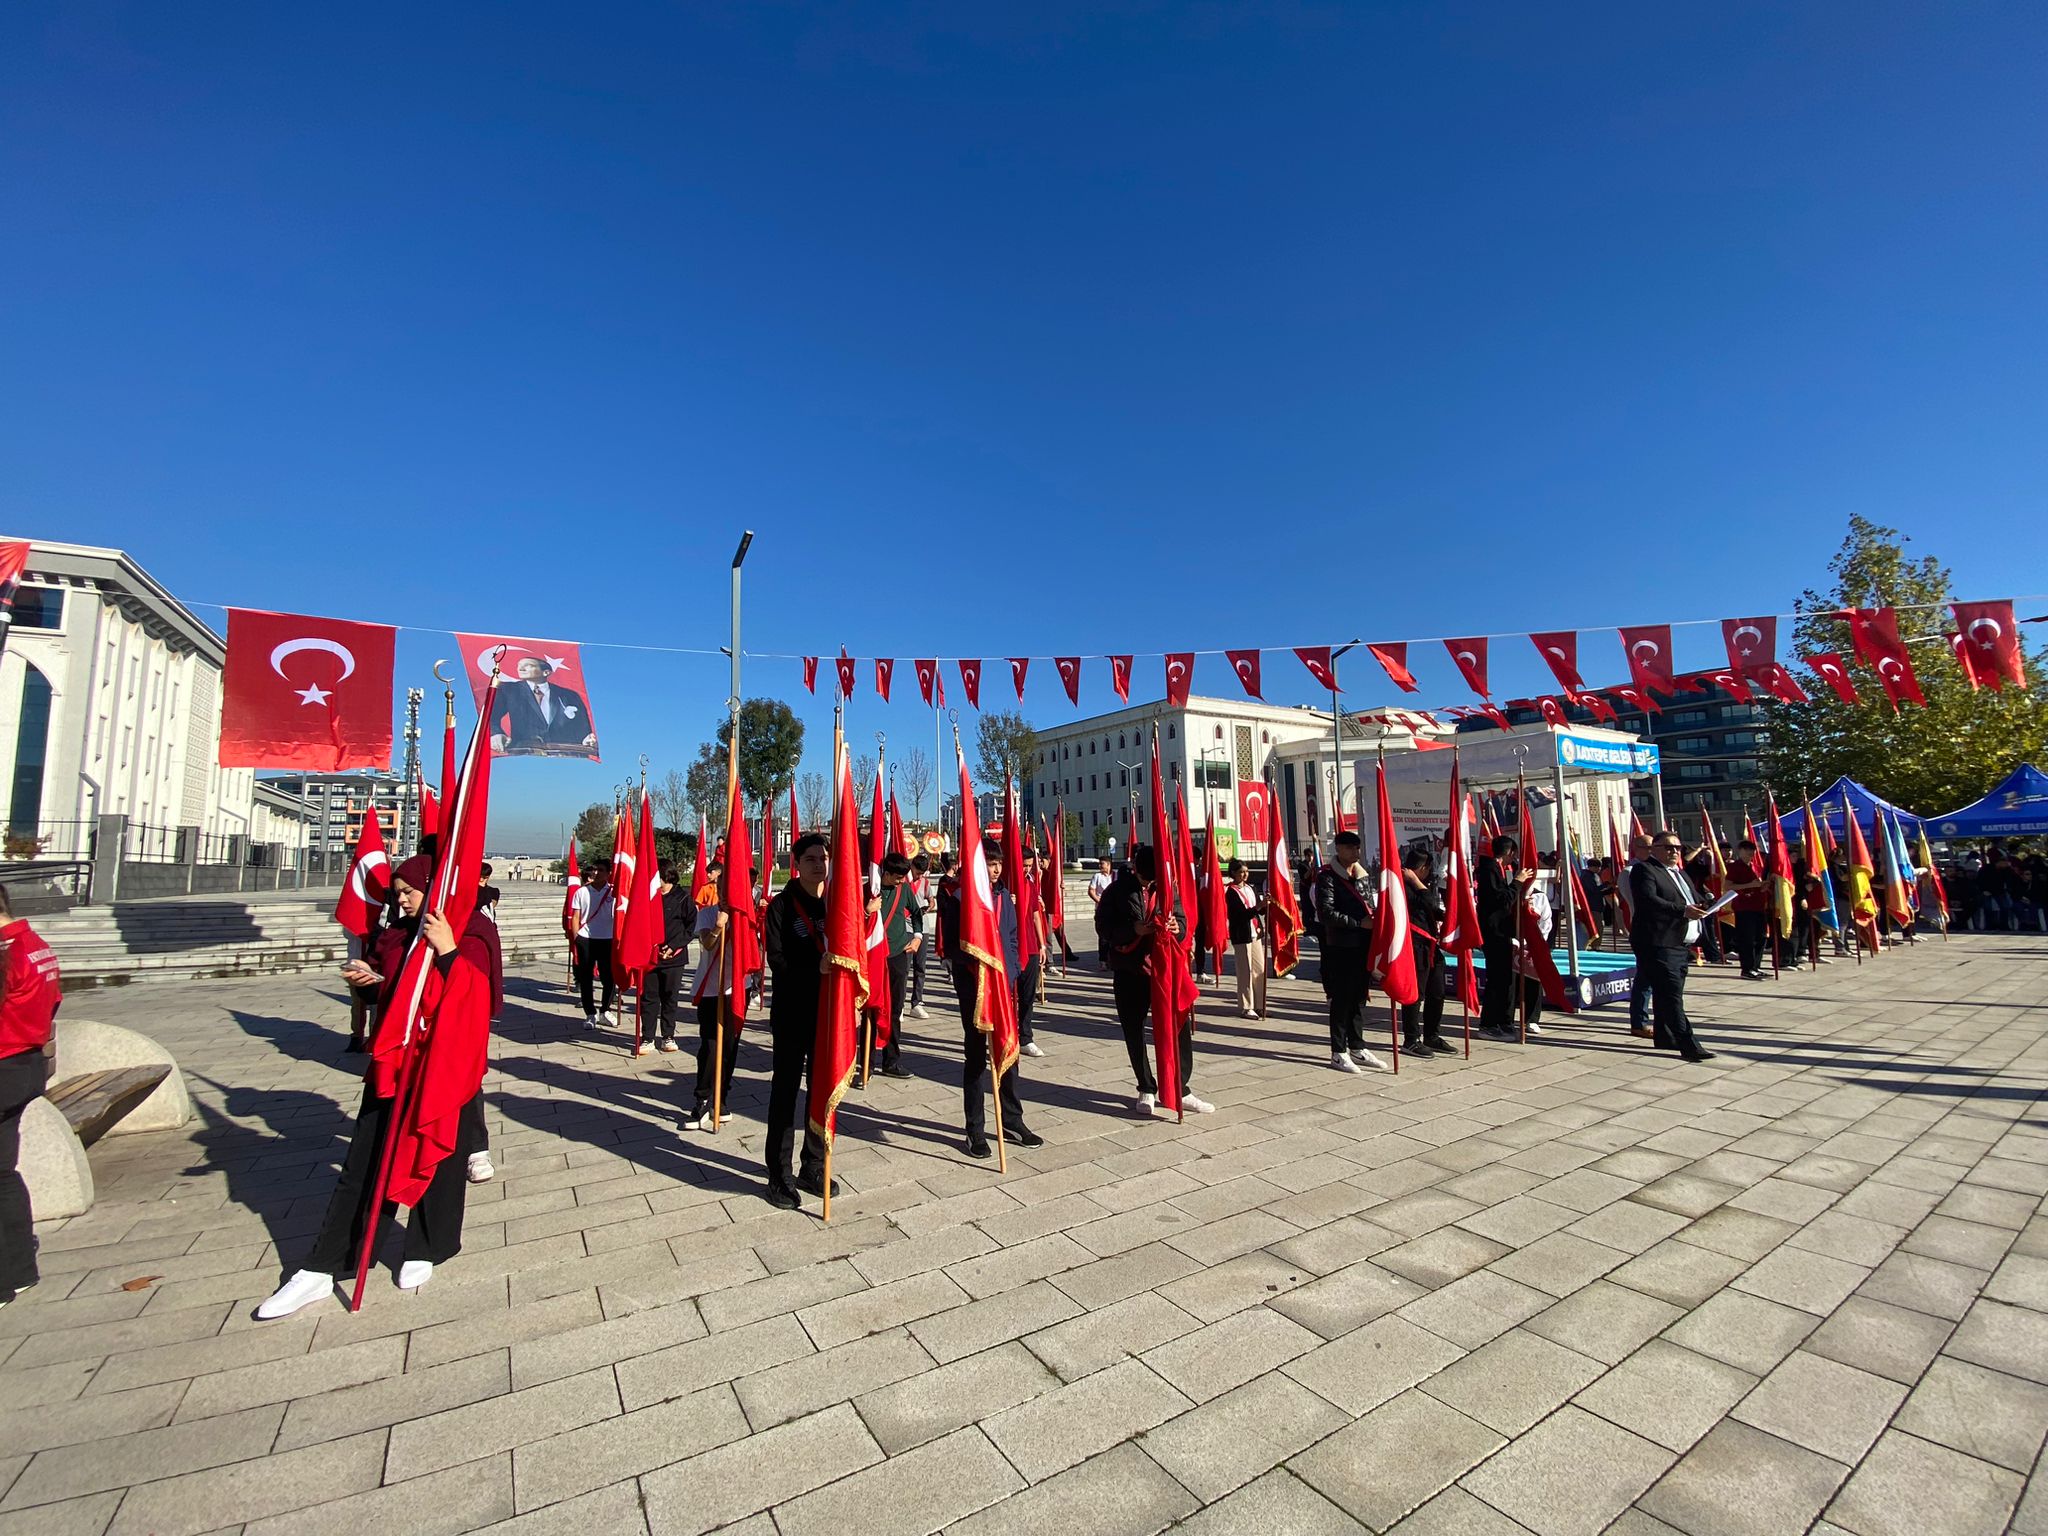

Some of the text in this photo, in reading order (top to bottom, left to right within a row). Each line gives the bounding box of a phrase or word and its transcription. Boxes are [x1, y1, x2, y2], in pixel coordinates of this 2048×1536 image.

[1575, 744, 1609, 763] KARTEPE
[1981, 823, 2019, 832] KARTEPE
[1594, 979, 1630, 997] KARTEPE
